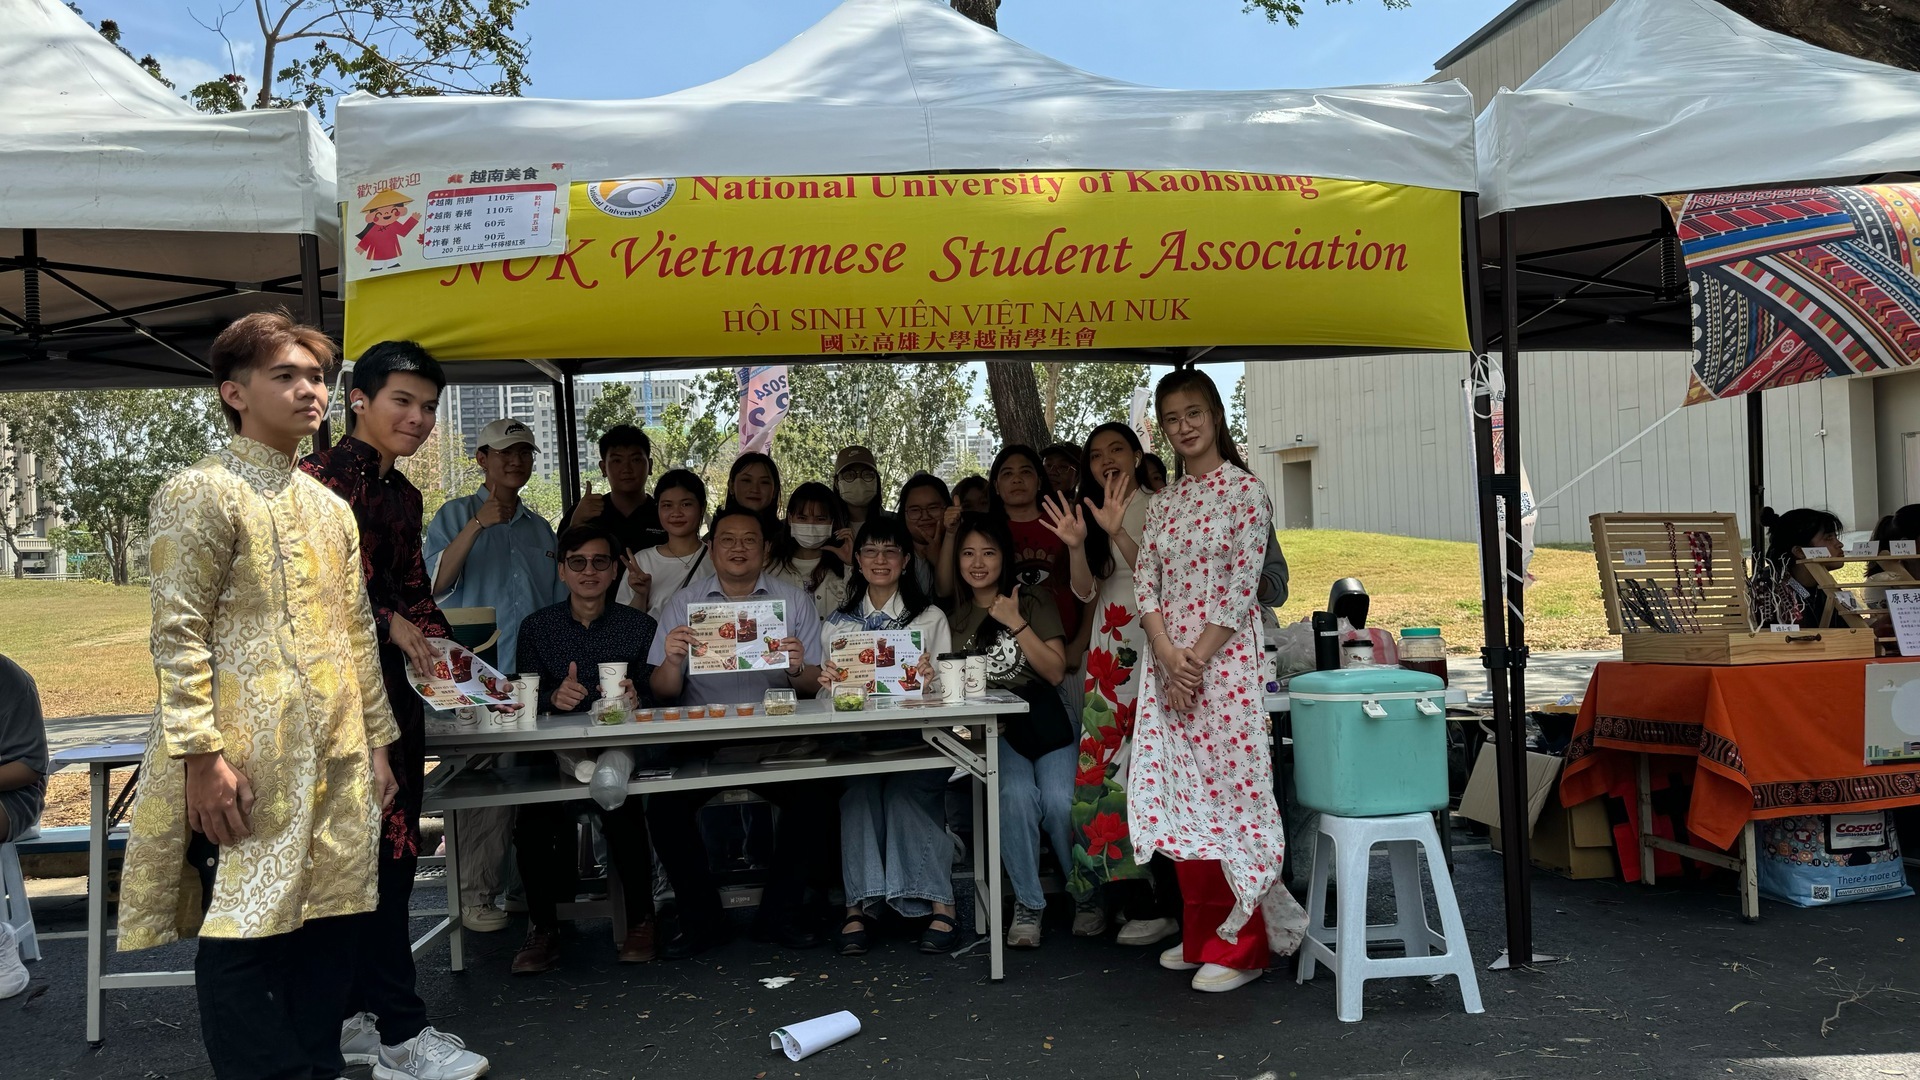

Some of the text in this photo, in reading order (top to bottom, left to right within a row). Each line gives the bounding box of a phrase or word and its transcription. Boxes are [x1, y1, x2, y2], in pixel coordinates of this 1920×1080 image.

[469, 167, 540, 184] 越南美食
[357, 173, 421, 199] 歡迎歡迎
[689, 171, 1320, 203] National University of Kaohsiung
[435, 198, 453, 207] 越南
[488, 194, 515, 202] 110元
[434, 211, 452, 220] 越南
[486, 206, 514, 215] 110元
[604, 205, 643, 217] University
[643, 206, 654, 214] of
[433, 224, 451, 233] 涼拌
[484, 219, 506, 228] 60元
[484, 232, 506, 241] 90元
[610, 230, 908, 279] Vietnamese
[929, 227, 1134, 283] Student
[1139, 228, 1408, 279] Association
[721, 297, 1192, 336] HỘI SINH VIÊN VIỆT NAM NUK
[820, 326, 1098, 353] 國立高雄大學越南學生會
[1837, 874, 1867, 885] There's
[1869, 871, 1890, 881] more
[1837, 884, 1894, 896] www.costco.com.tw
